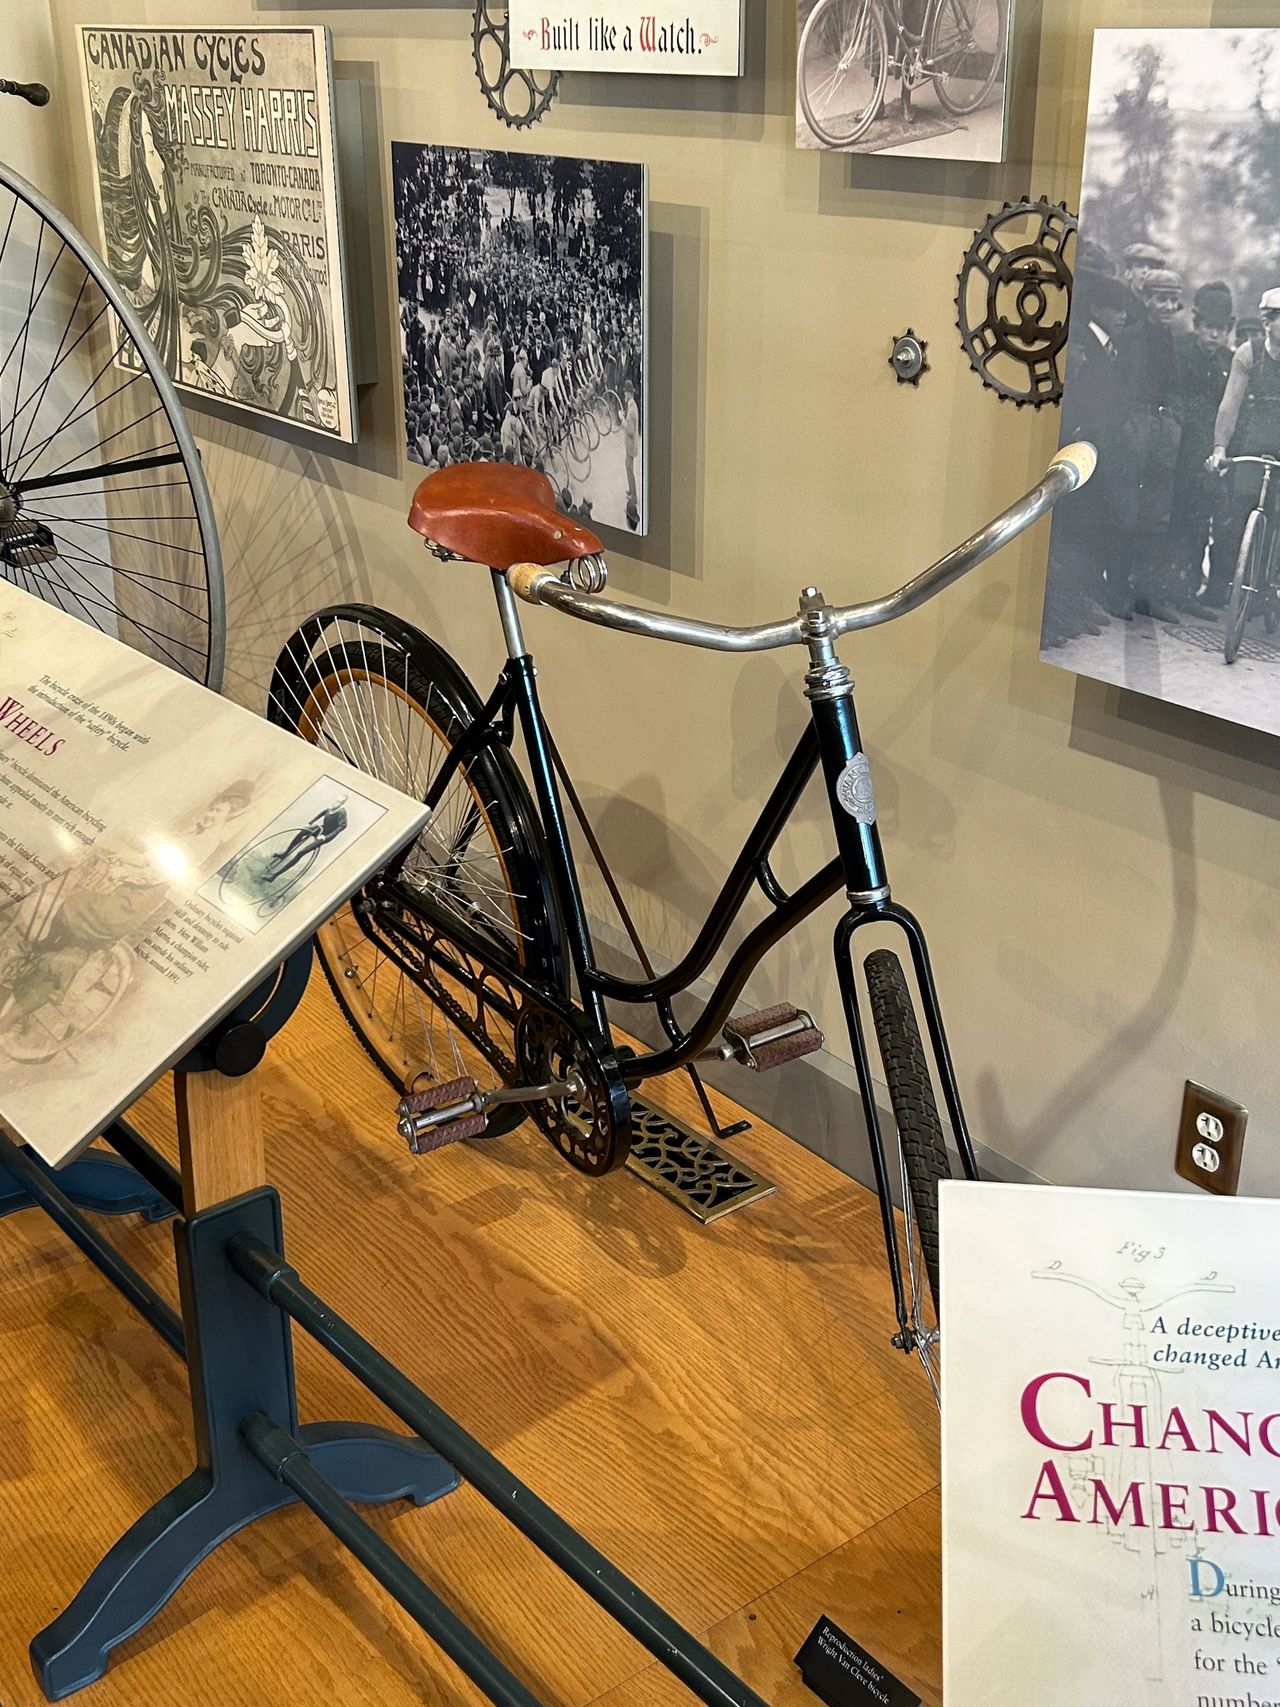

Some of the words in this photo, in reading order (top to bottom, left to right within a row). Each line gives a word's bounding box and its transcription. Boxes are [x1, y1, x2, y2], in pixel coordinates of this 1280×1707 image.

[540, 17, 580, 51] Built
[589, 17, 617, 52] like
[623, 25, 633, 52] a
[640, 16, 702, 55] Watch.
[193, 34, 266, 85] CYCLES
[163, 85, 236, 151] MASSEY
[240, 88, 319, 158] HARRIS
[212, 186, 249, 213] CANADA
[273, 195, 301, 221] MOTOR
[280, 230, 325, 260] PARIS
[27, 685, 39, 695] the
[74, 714, 87, 724] the
[39, 674, 51, 686] The
[50, 682, 70, 697] bicycle
[114, 721, 135, 737] began
[133, 732, 151, 745] with
[61, 795, 84, 816] American
[14, 843, 36, 861] United
[177, 927, 191, 940] Here
[1117, 1241, 1150, 1262] Fig
[1150, 1316, 1168, 1334] A
[1176, 1317, 1280, 1343] deceptive
[1153, 1344, 1247, 1371] changed
[1020, 1459, 1280, 1537] AMERI
[1186, 1556, 1280, 1605] During
[1191, 1617, 1202, 1632] a
[1211, 1612, 1280, 1641] bicycle
[822, 1626, 862, 1666] Reproduction
[1194, 1648, 1225, 1671] for
[1233, 1652, 1268, 1675] the
[818, 1636, 838, 1659] Wright
[838, 1655, 850, 1670] Van
[850, 1666, 868, 1685] Cleve
[868, 1682, 890, 1705] bicycle
